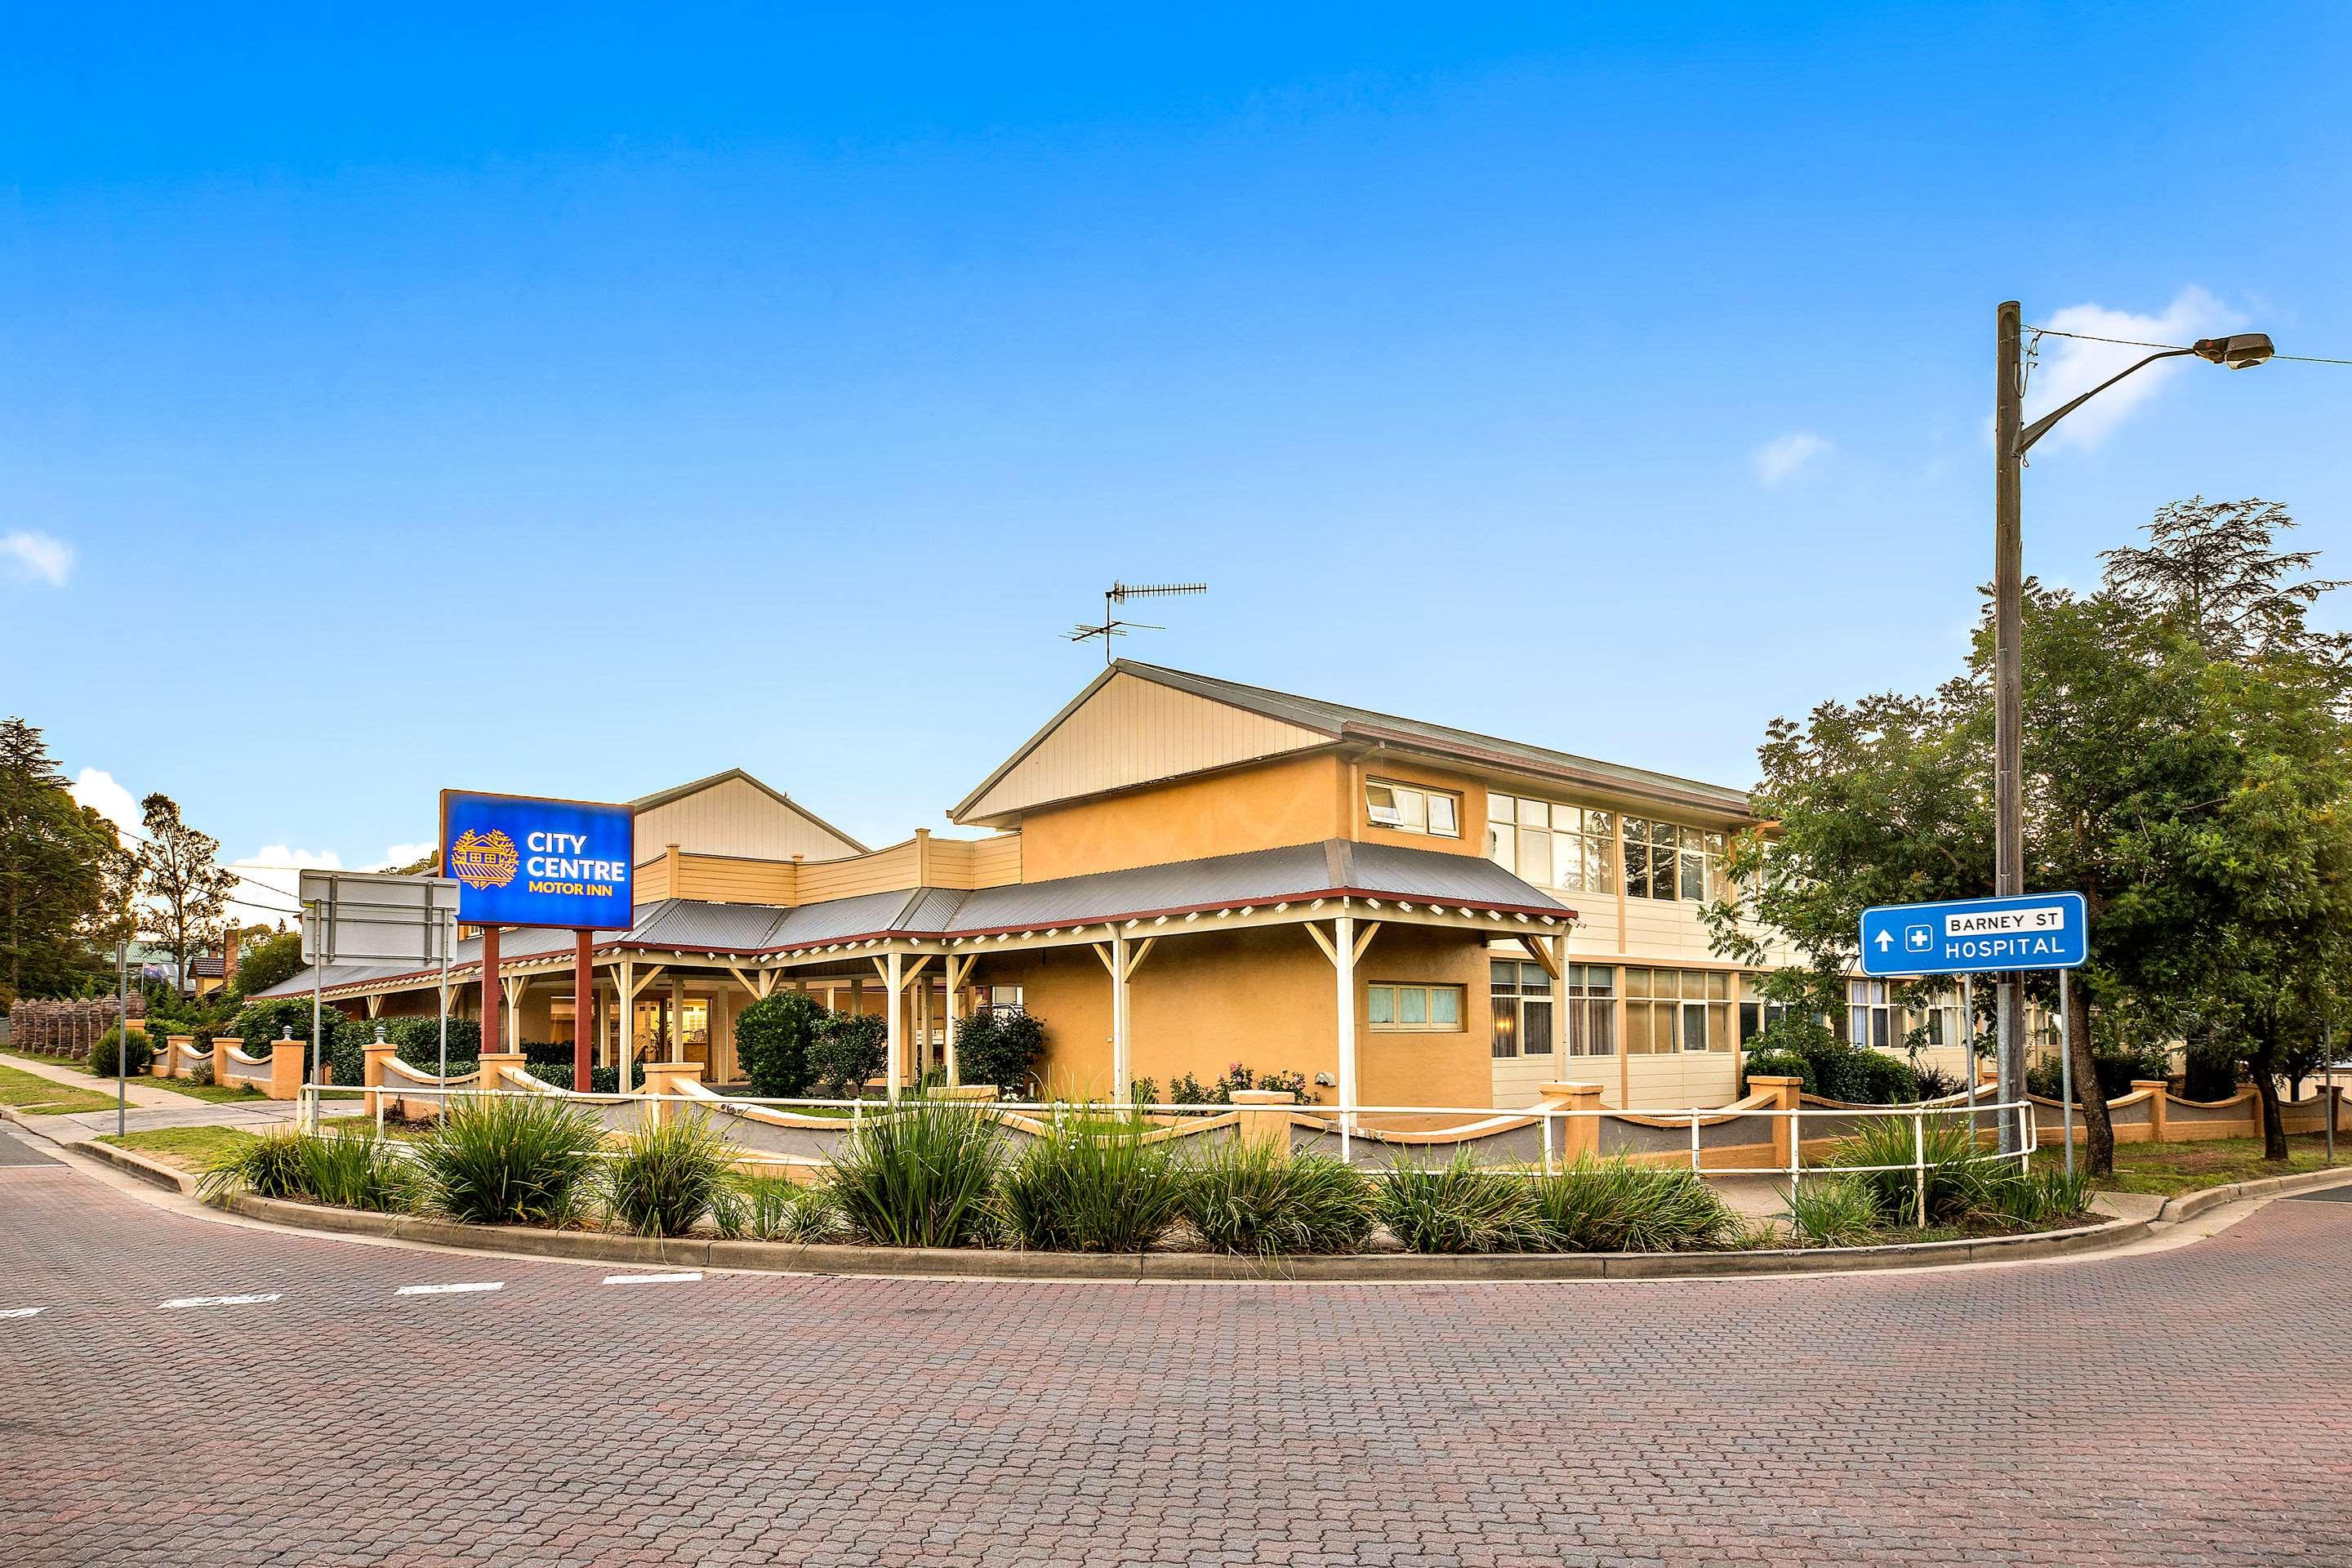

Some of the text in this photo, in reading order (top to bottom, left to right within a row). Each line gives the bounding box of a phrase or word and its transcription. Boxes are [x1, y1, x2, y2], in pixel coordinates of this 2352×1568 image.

[528, 831, 587, 854] CITY
[527, 856, 625, 882] CENTRE
[529, 881, 612, 897] MOTOR INN
[1951, 913, 2058, 931] BARNEY ST
[1945, 937, 2065, 959] HOSPITAL
